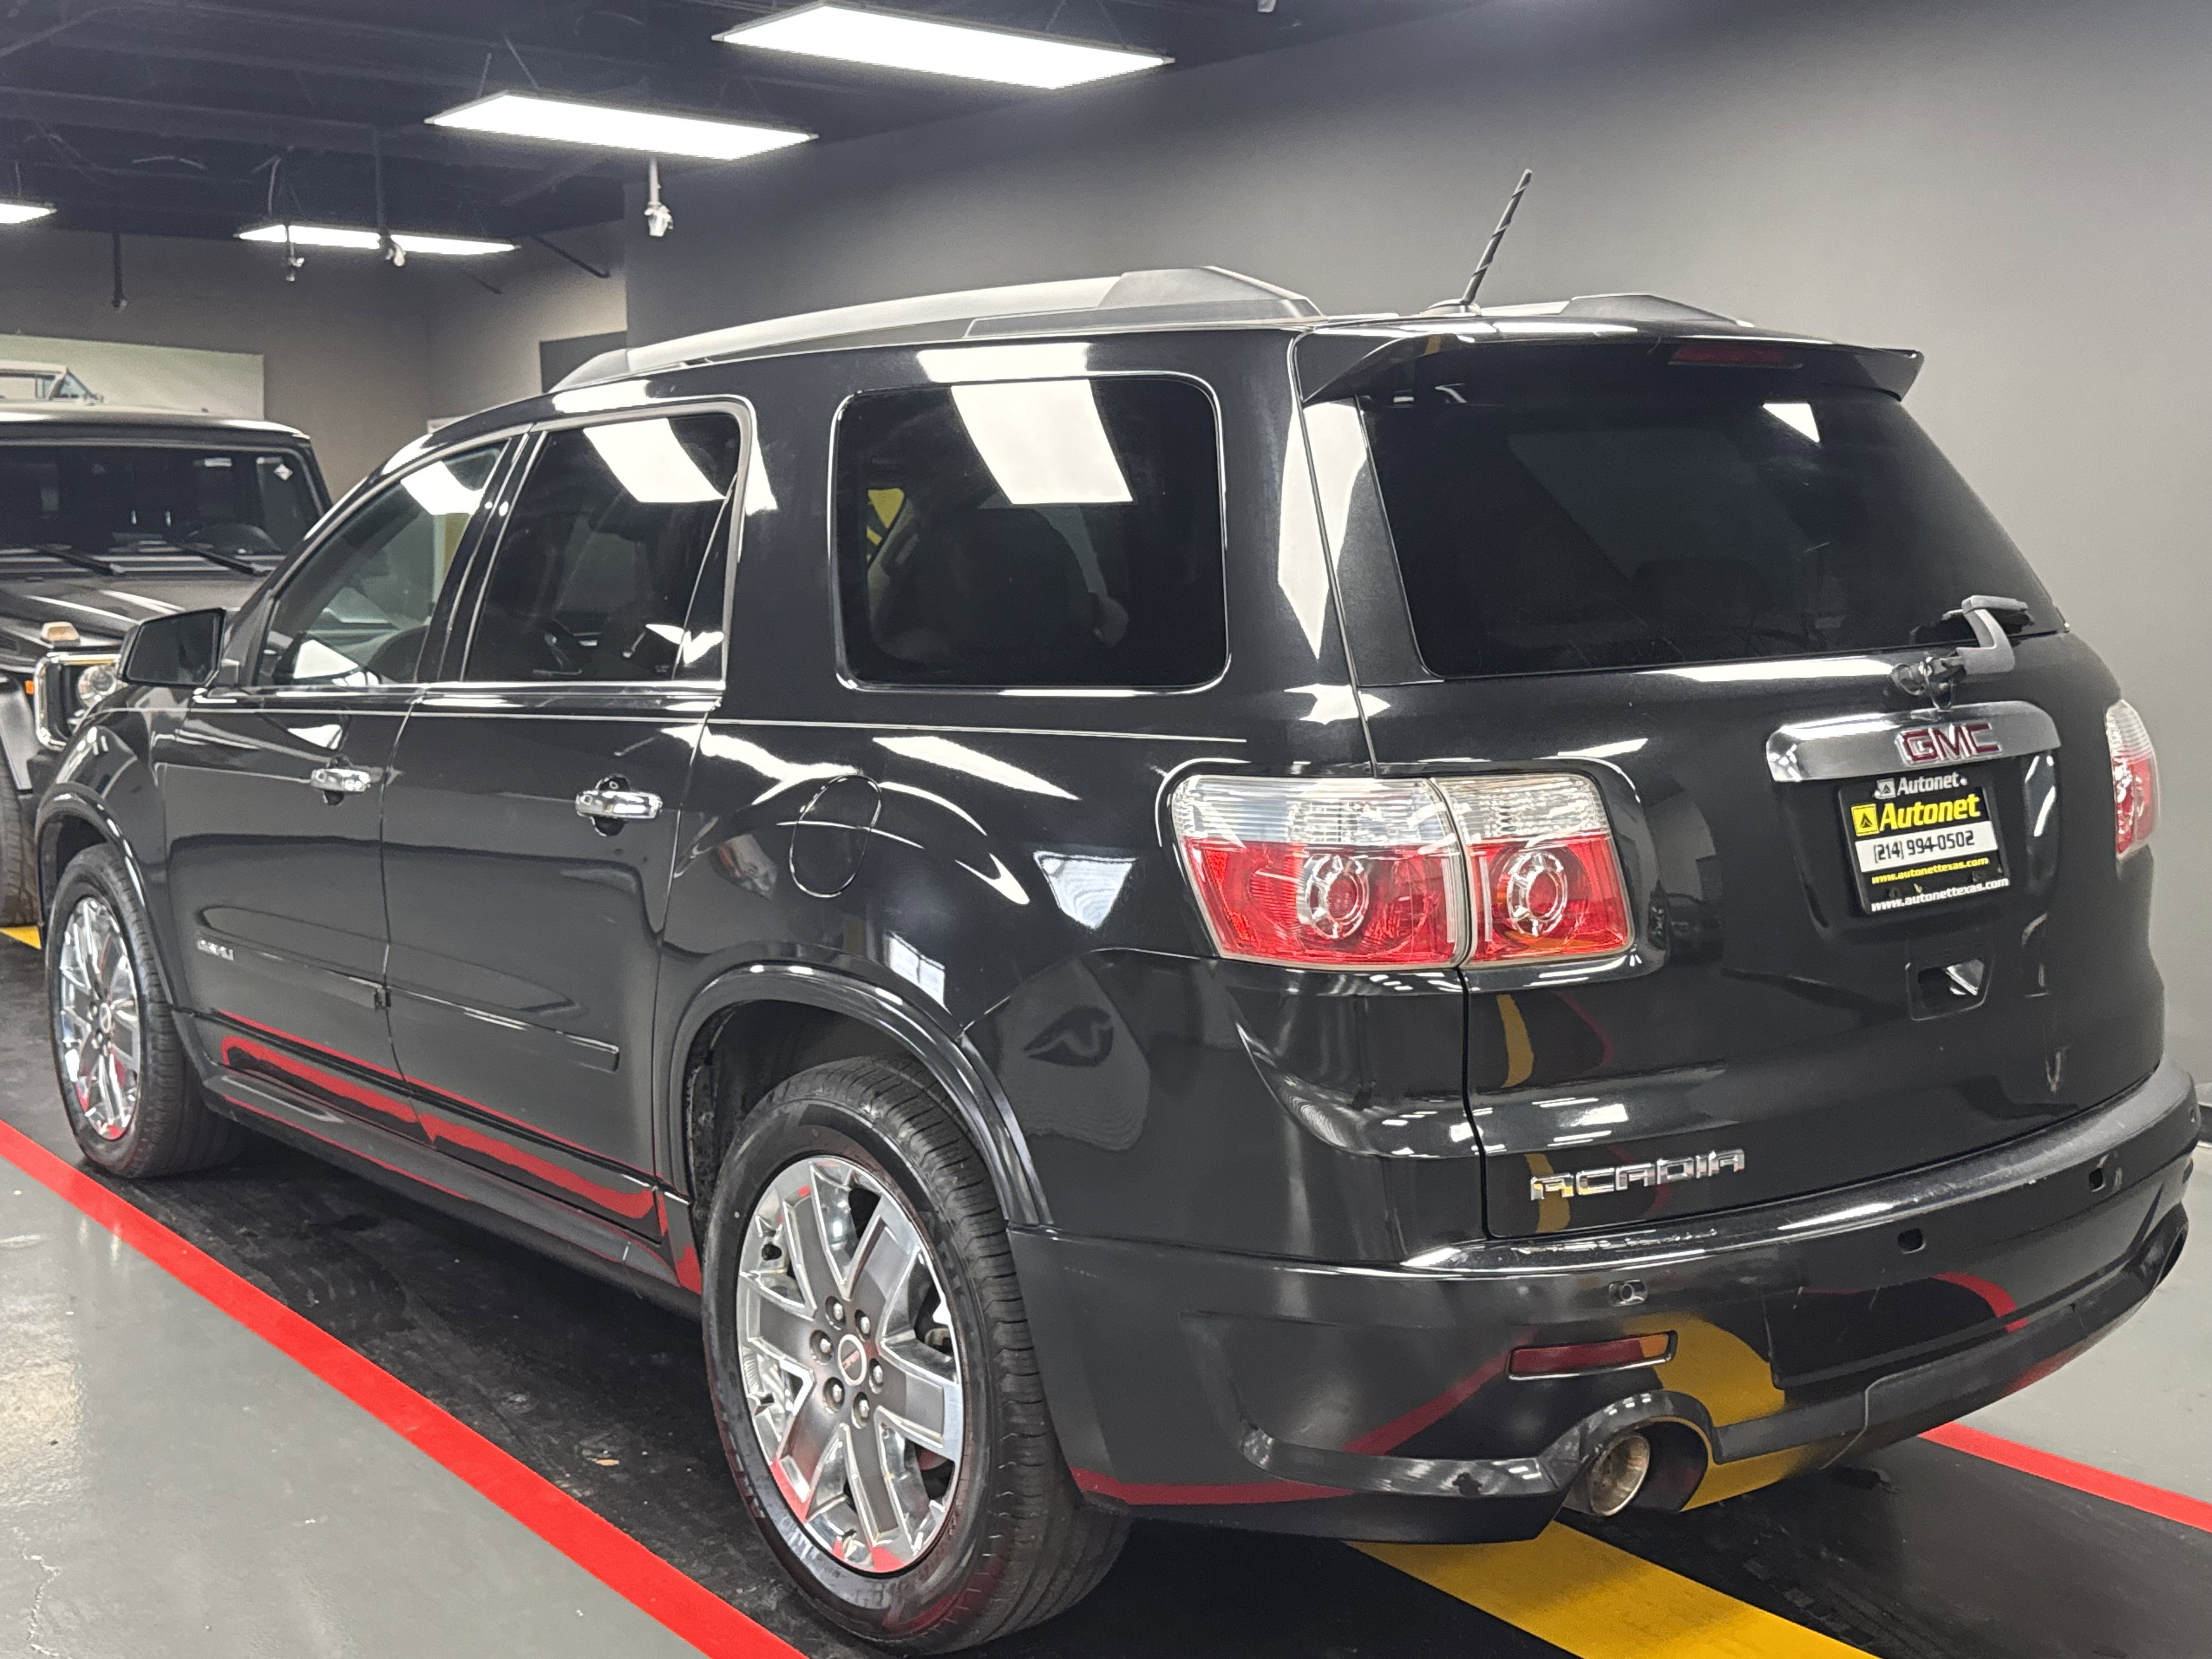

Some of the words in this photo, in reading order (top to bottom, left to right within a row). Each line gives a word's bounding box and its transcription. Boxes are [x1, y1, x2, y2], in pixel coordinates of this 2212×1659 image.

[1897, 723, 2002, 765] GMC
[1897, 771, 1959, 796] Autonet
[1880, 793, 1981, 832] Autonet
[1874, 840, 1904, 864] (214)
[1906, 830, 1975, 856] 994-0502
[1871, 857, 1990, 884] www.autonettexas.com
[1871, 878, 2009, 912] www.autonettexas.com
[1531, 1149, 1745, 1201] ACADIA
